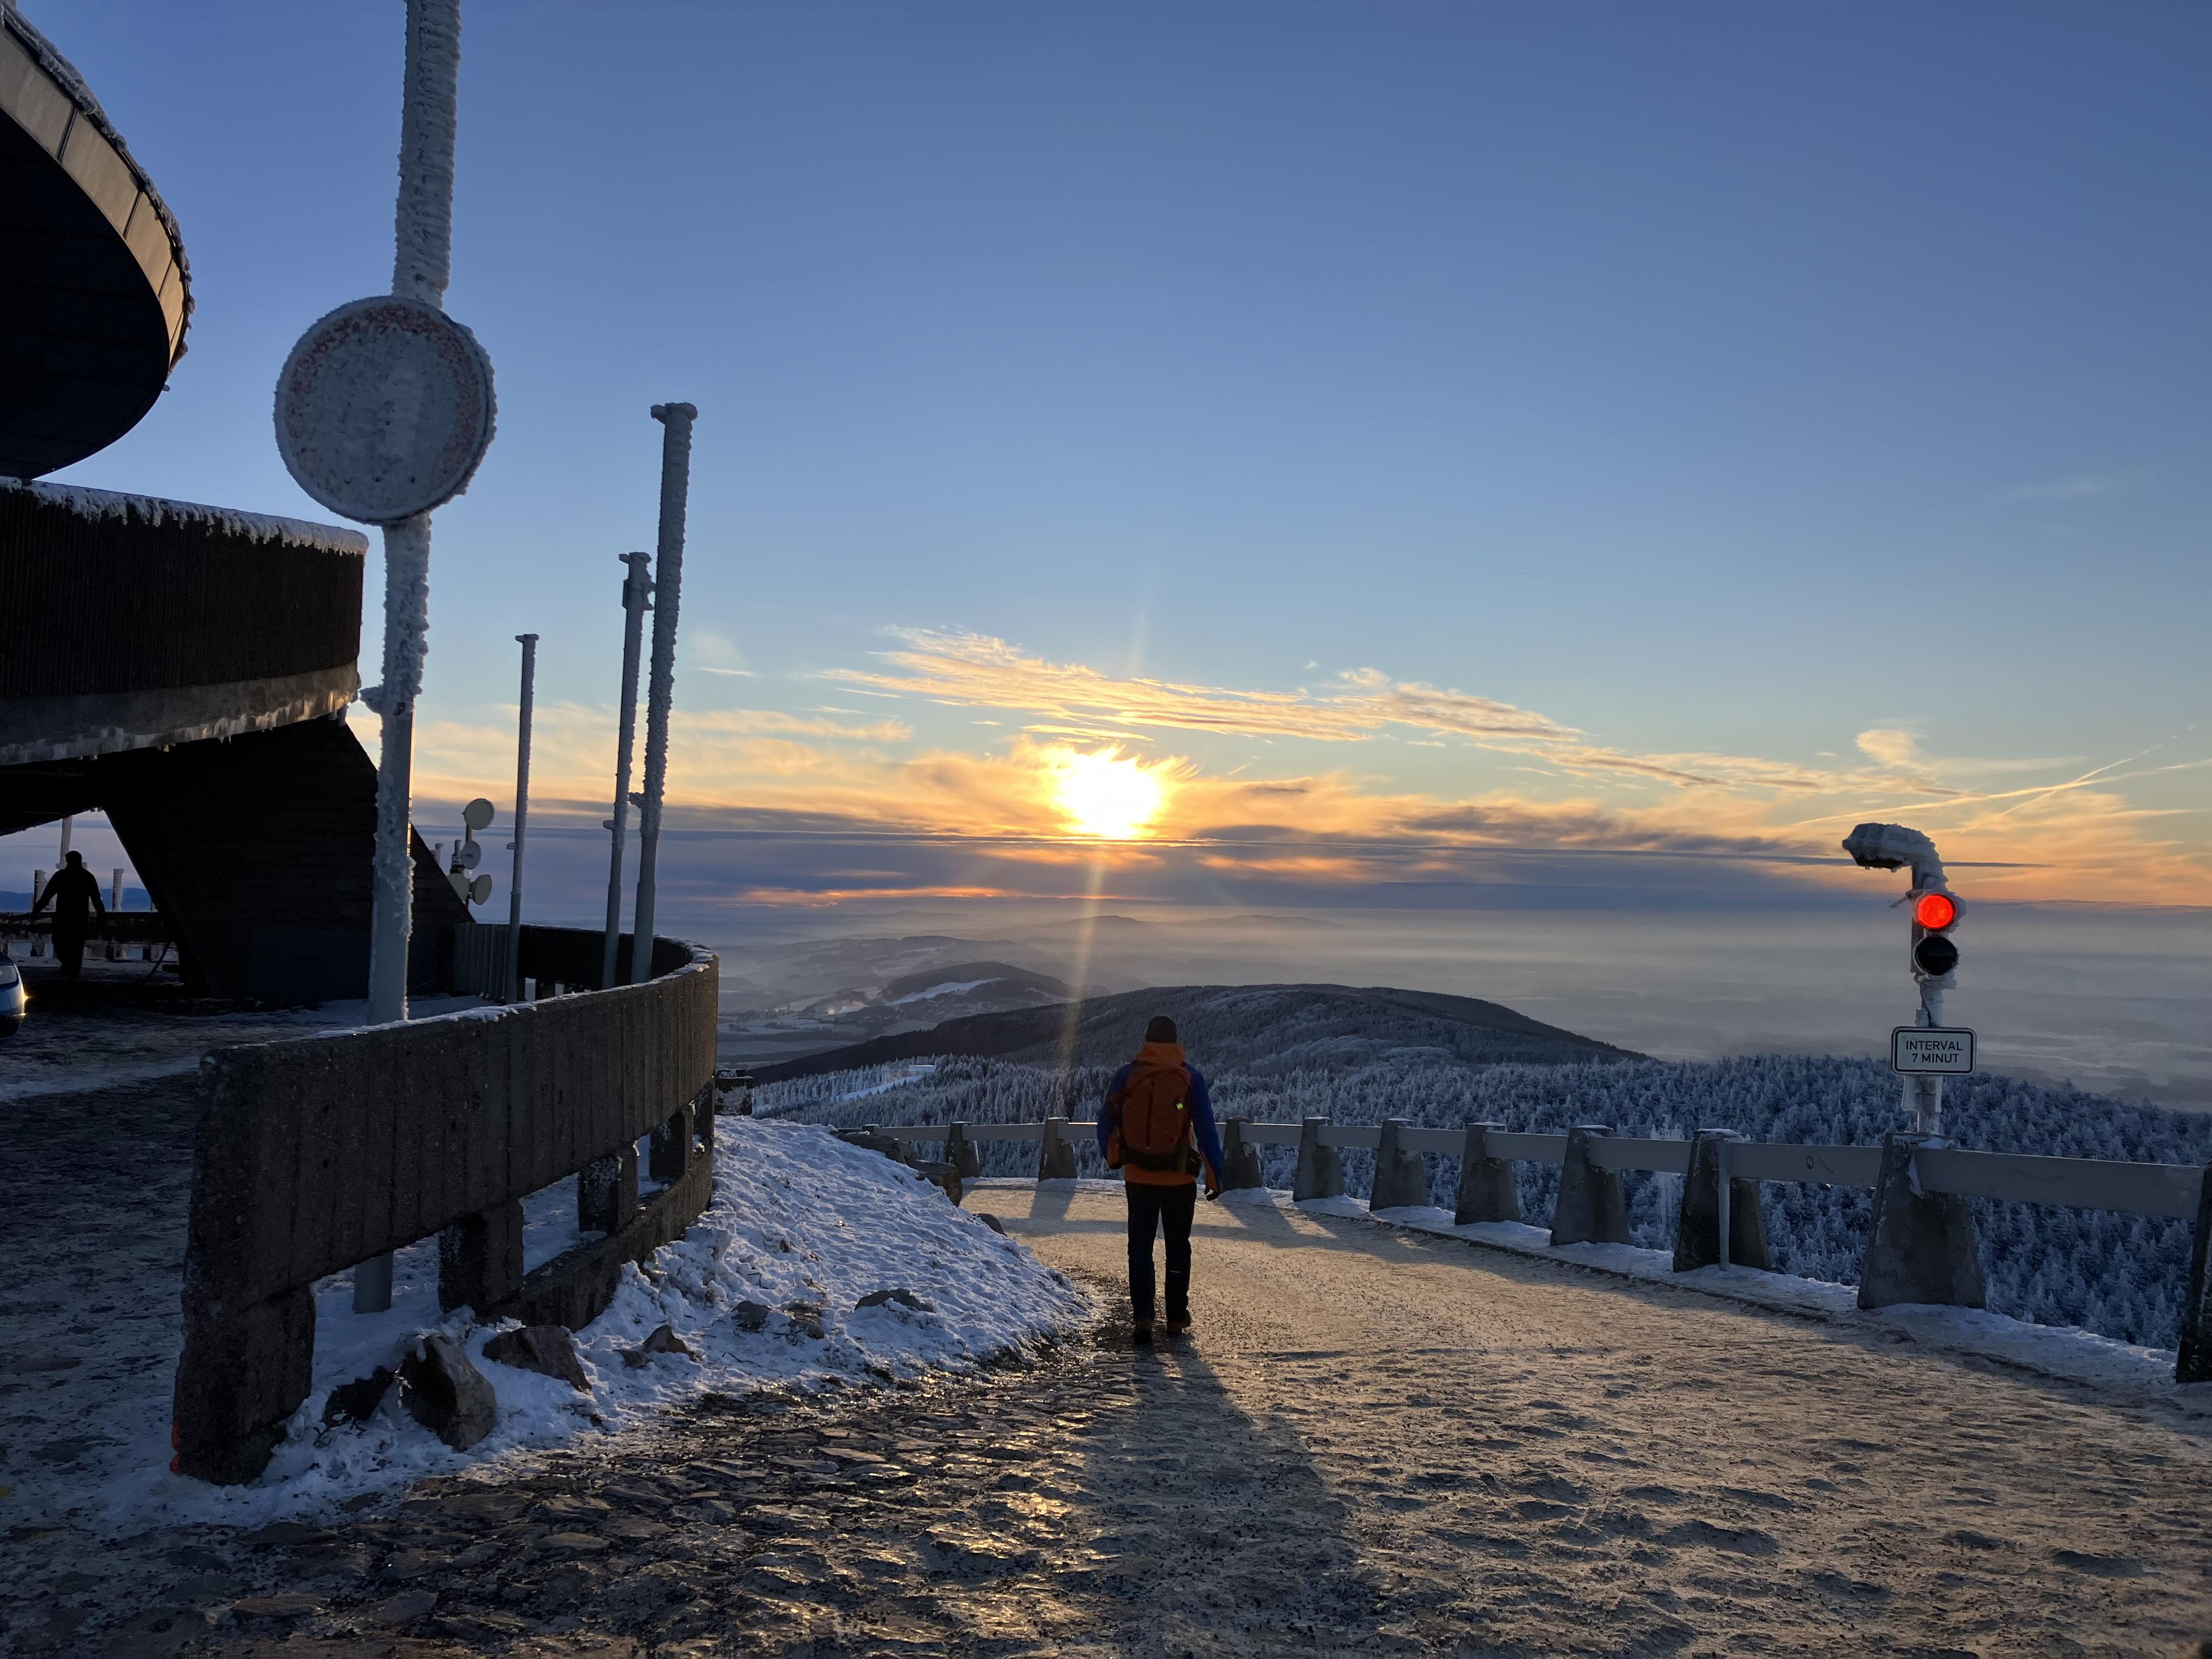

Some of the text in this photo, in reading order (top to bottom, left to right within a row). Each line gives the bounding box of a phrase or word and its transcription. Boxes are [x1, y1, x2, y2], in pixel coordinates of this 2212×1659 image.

[1906, 1041, 1963, 1051] INTERVAL
[1912, 1053, 1959, 1063] 7 MINUT
